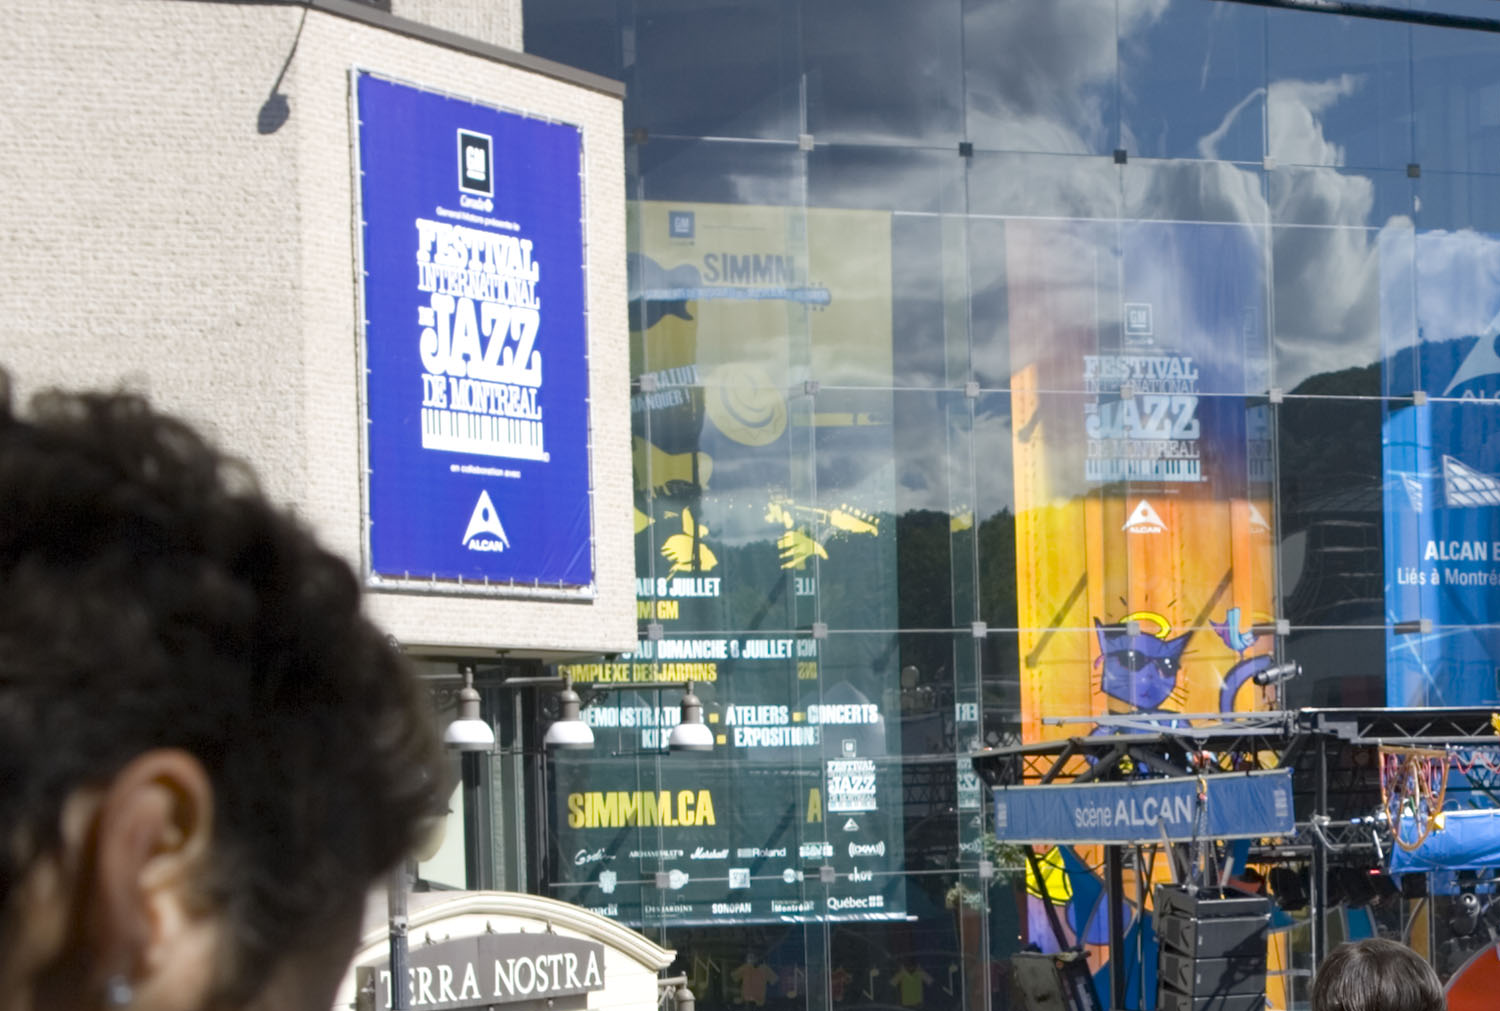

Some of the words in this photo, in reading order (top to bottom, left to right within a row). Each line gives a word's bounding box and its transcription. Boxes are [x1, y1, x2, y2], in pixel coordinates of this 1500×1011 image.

[416, 217, 539, 282] FESTIVAL
[417, 261, 541, 310] INTERNATIONAL
[1129, 310, 1147, 325] GM
[419, 292, 542, 388] JAZZ
[1083, 356, 1199, 379] FESTIVAL
[421, 373, 447, 409] DE
[448, 377, 542, 420] MONTREAL
[1085, 395, 1200, 440] JAZZ
[468, 539, 504, 552] ALCAN
[1423, 540, 1488, 561] ALCAN
[656, 577, 668, 597] 8
[669, 577, 721, 597] JUILLET
[1397, 567, 1426, 586] Liés
[1430, 568, 1441, 586] à
[656, 601, 680, 619] GM
[657, 638, 729, 660] DIMANCHE
[729, 639, 740, 659] 8
[741, 638, 794, 659] JUILLET
[725, 705, 789, 725] ATELIERS
[807, 703, 879, 724] CONCERTS
[829, 775, 876, 794] JAZZ
[1075, 803, 1113, 828] scène
[1114, 796, 1192, 827] ALCAN
[752, 847, 787, 858] Roland
[826, 896, 868, 911] Québec
[494, 950, 602, 998] NOSTRA
